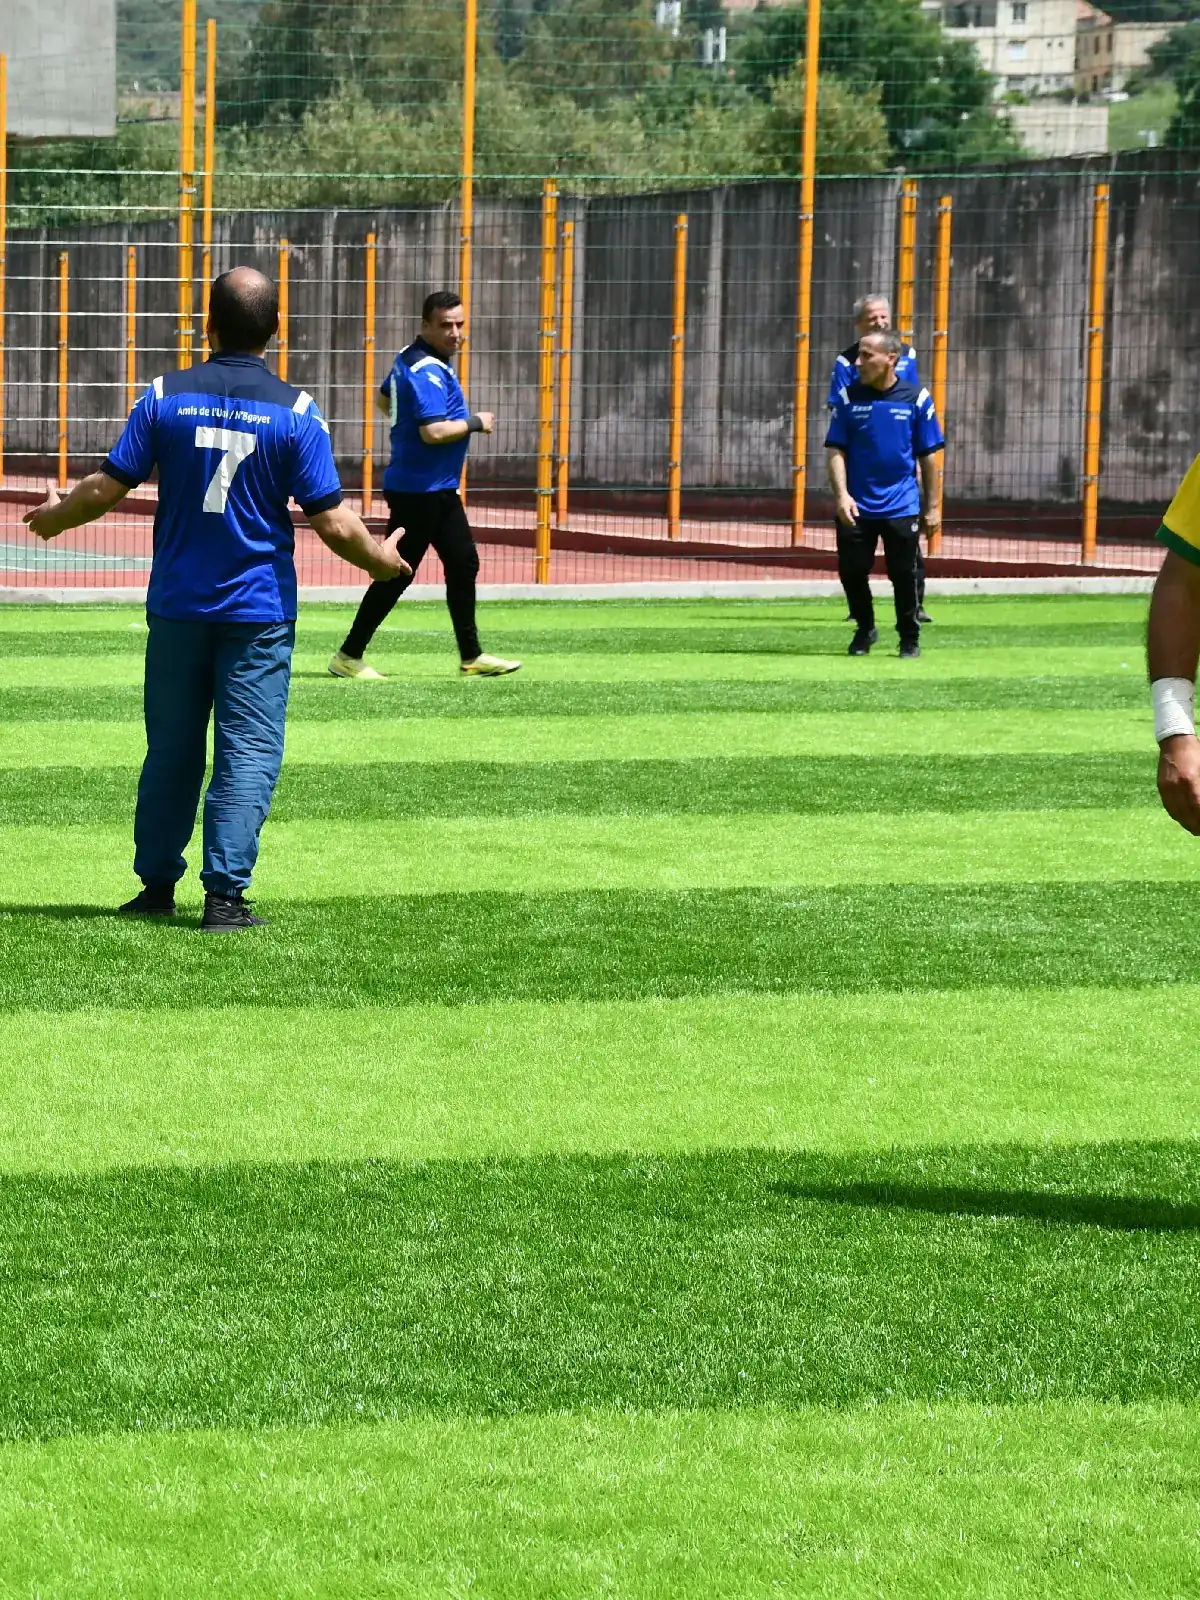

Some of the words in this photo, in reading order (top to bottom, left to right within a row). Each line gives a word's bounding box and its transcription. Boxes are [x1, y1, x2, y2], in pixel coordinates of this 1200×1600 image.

[177, 405, 198, 416] Amis
[199, 405, 210, 417] de
[194, 426, 257, 514] 7
